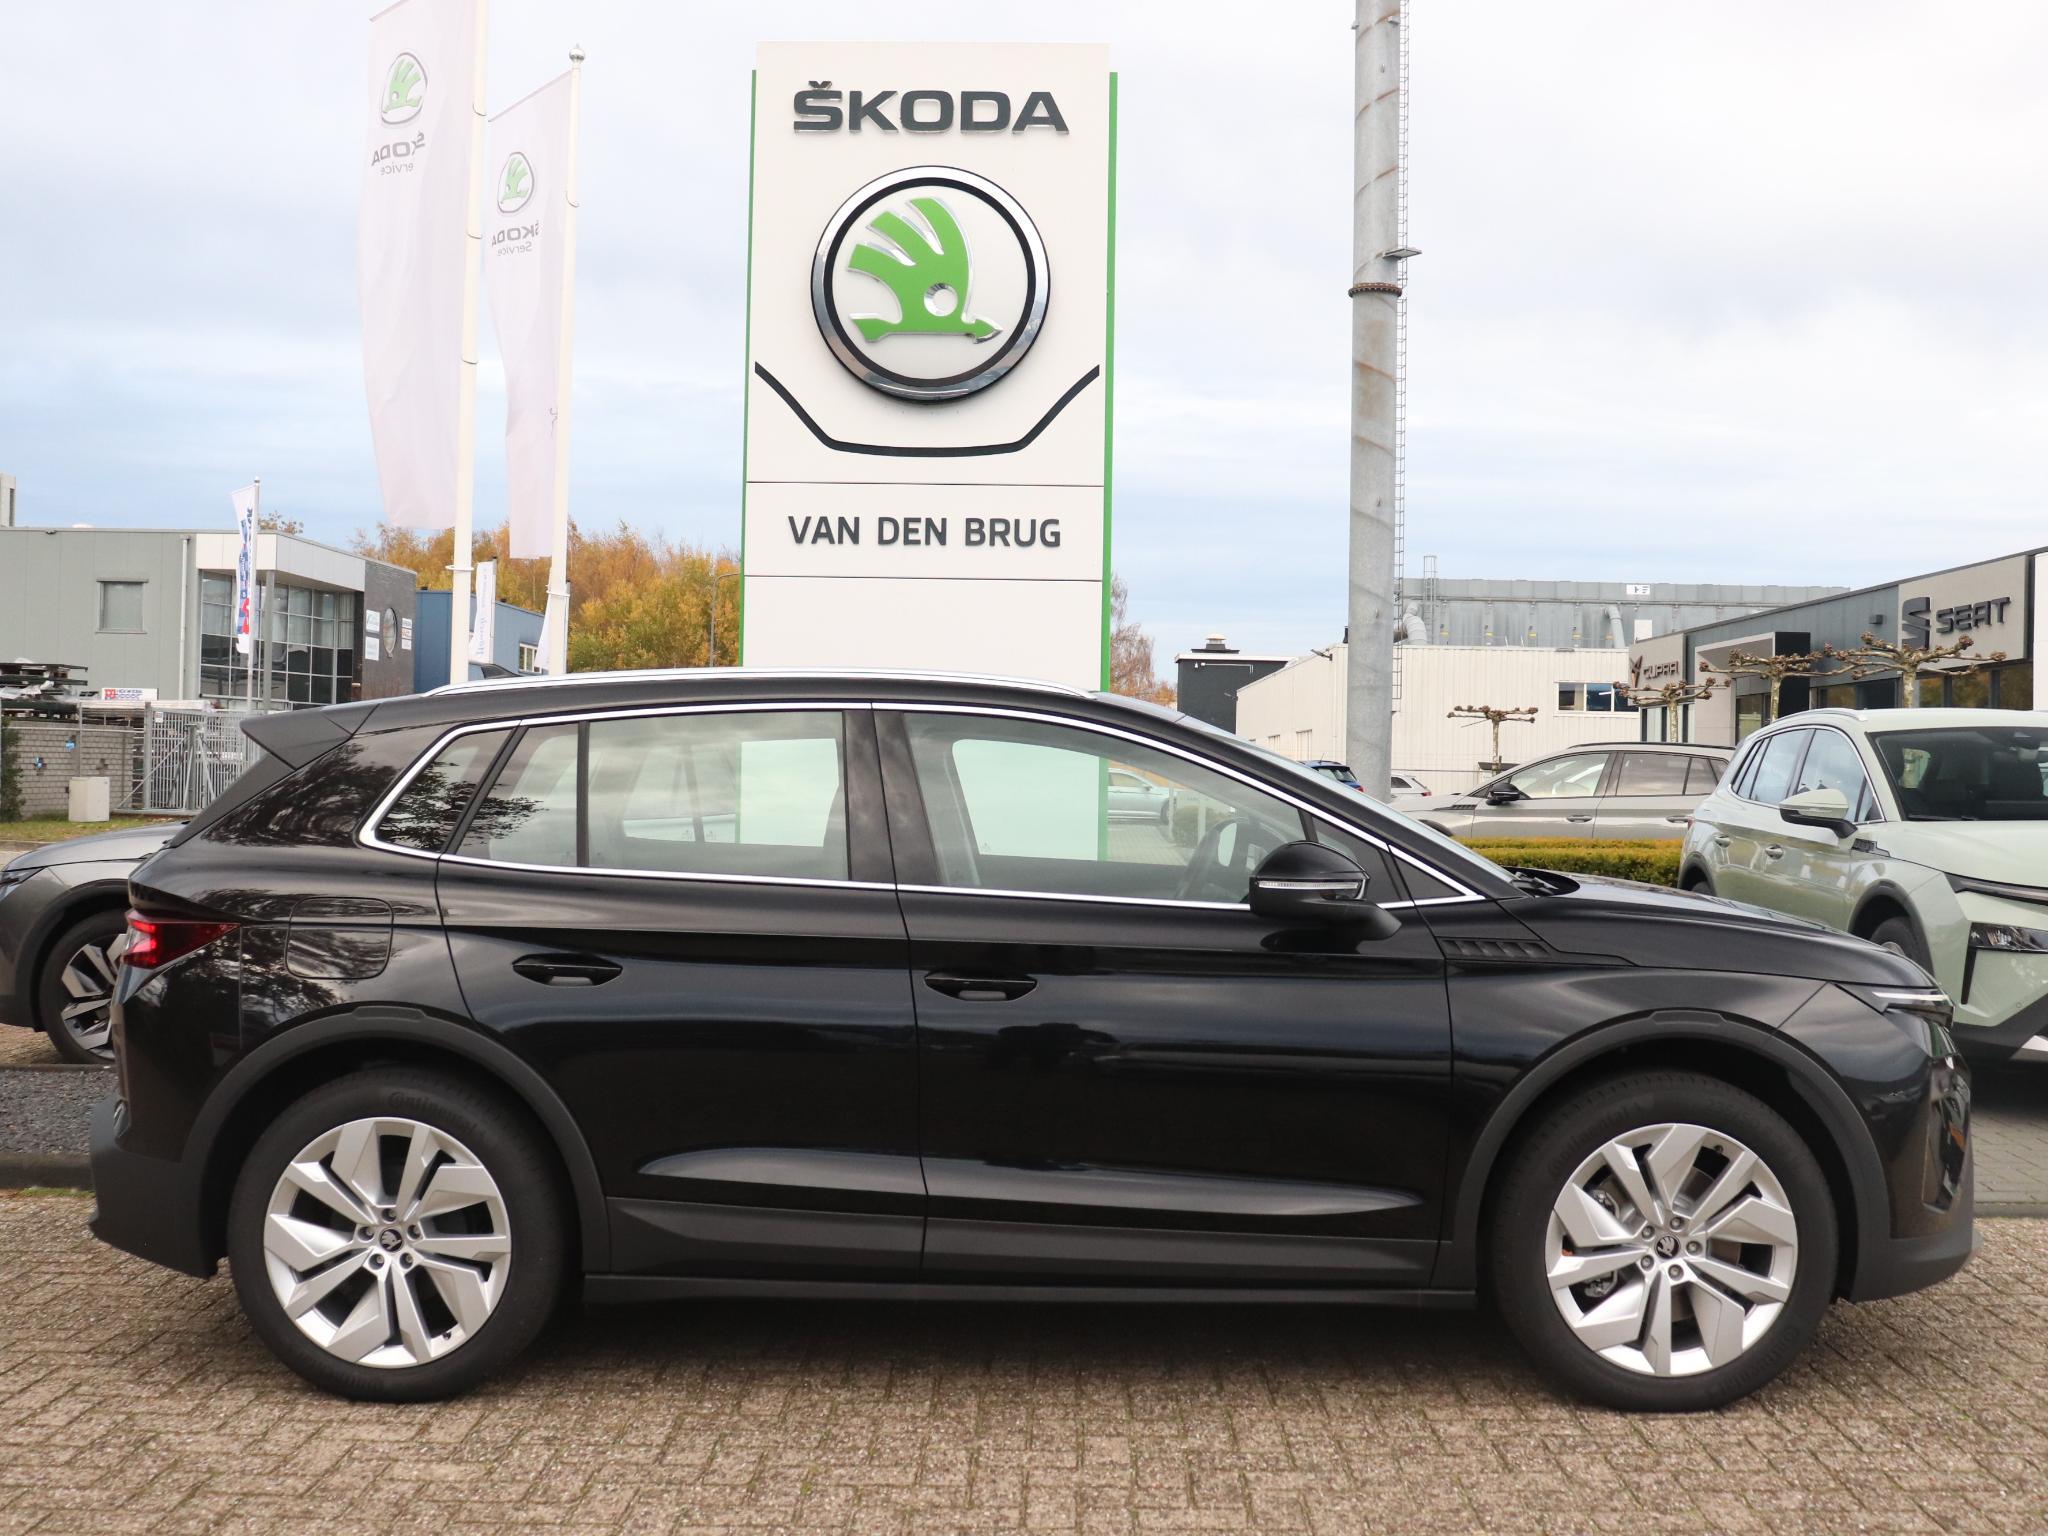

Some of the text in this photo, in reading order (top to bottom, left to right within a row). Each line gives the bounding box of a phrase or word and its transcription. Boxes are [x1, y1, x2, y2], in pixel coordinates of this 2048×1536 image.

[794, 81, 1069, 134] ŠKODA
[788, 516, 1061, 547] VAN DEN BRUG
[1936, 597, 2011, 634] SEAT
[1643, 661, 1679, 679] CUPRA
